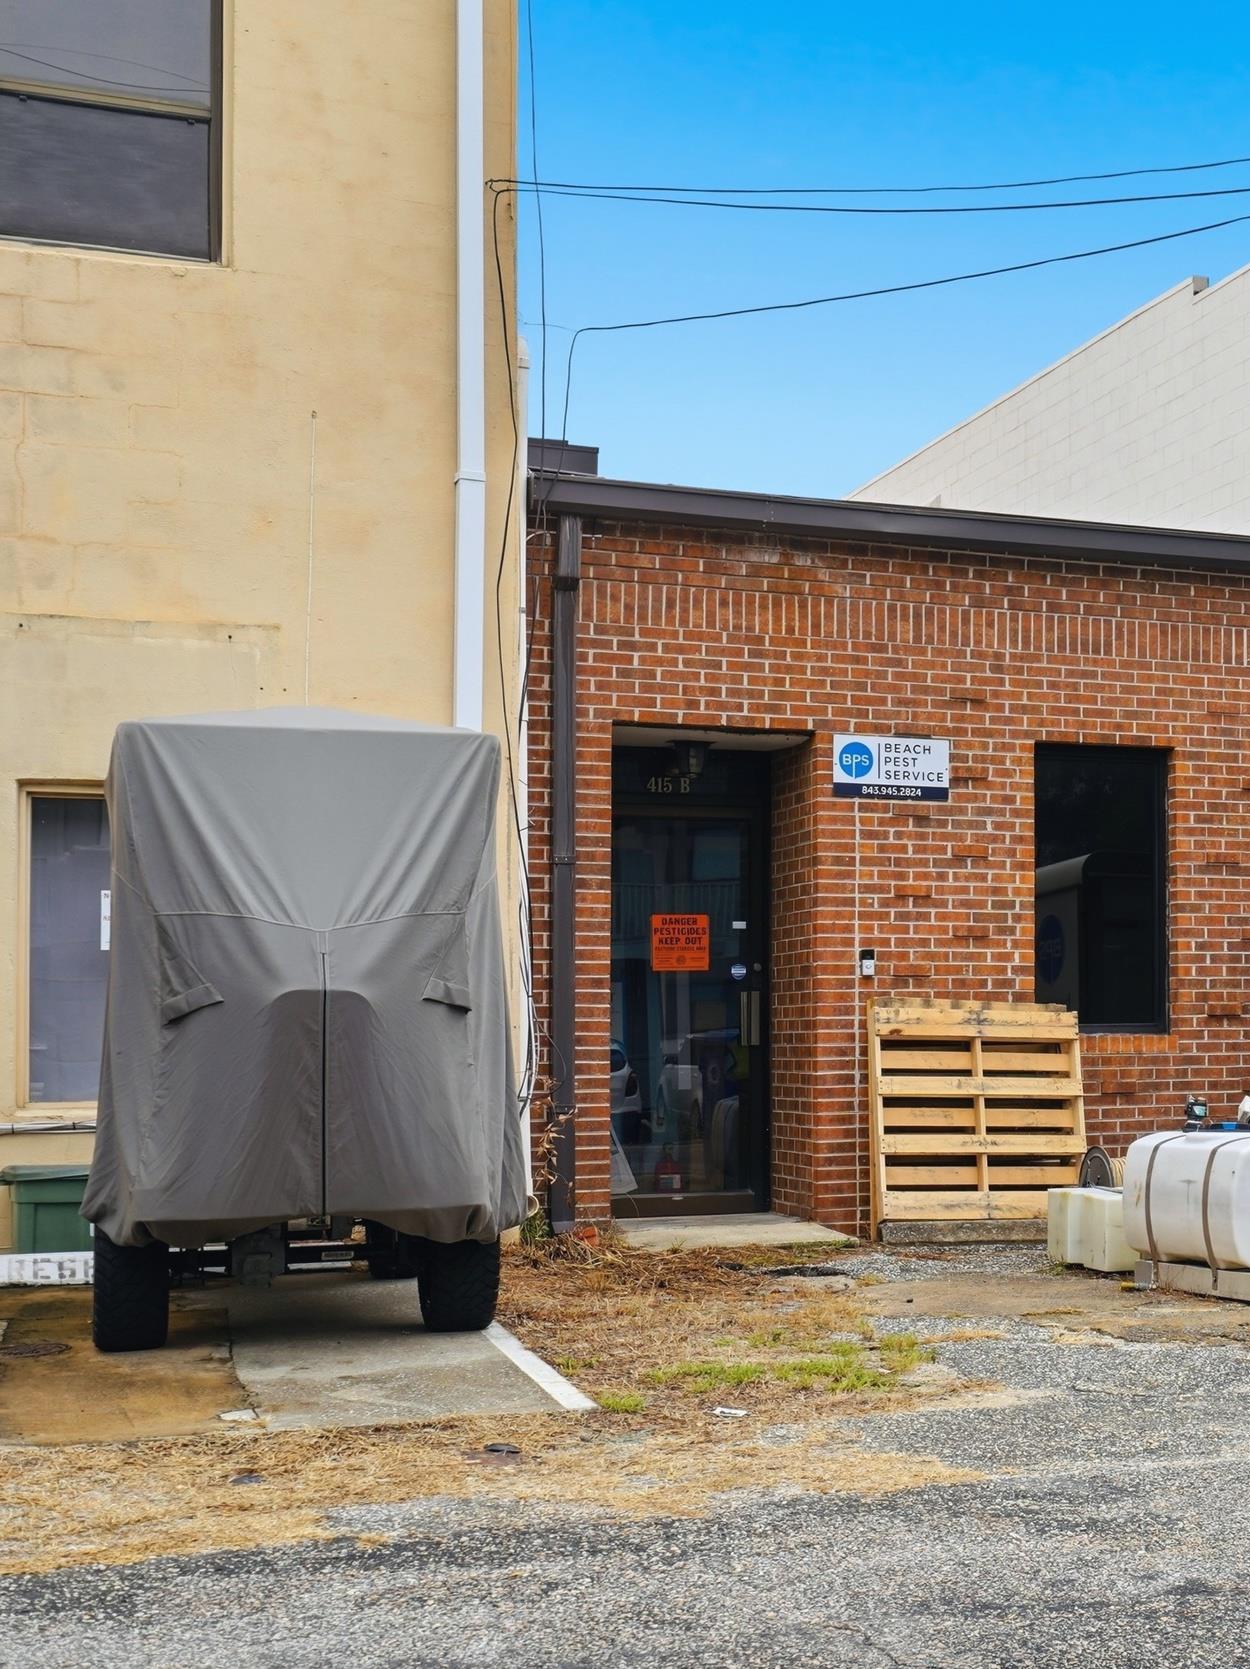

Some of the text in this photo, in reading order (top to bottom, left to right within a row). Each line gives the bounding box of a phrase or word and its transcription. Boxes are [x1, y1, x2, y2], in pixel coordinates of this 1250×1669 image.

[884, 743, 931, 755] BEACH
[842, 753, 870, 779] BPS
[884, 756, 918, 768] PEST
[884, 770, 944, 782] SERVICE
[646, 776, 690, 793] 415 B
[861, 785, 922, 797] 843.945.2824
[661, 917, 698, 926] DANGER
[653, 927, 707, 936] PESTICIDES
[658, 936, 703, 945] KEEP OUT
